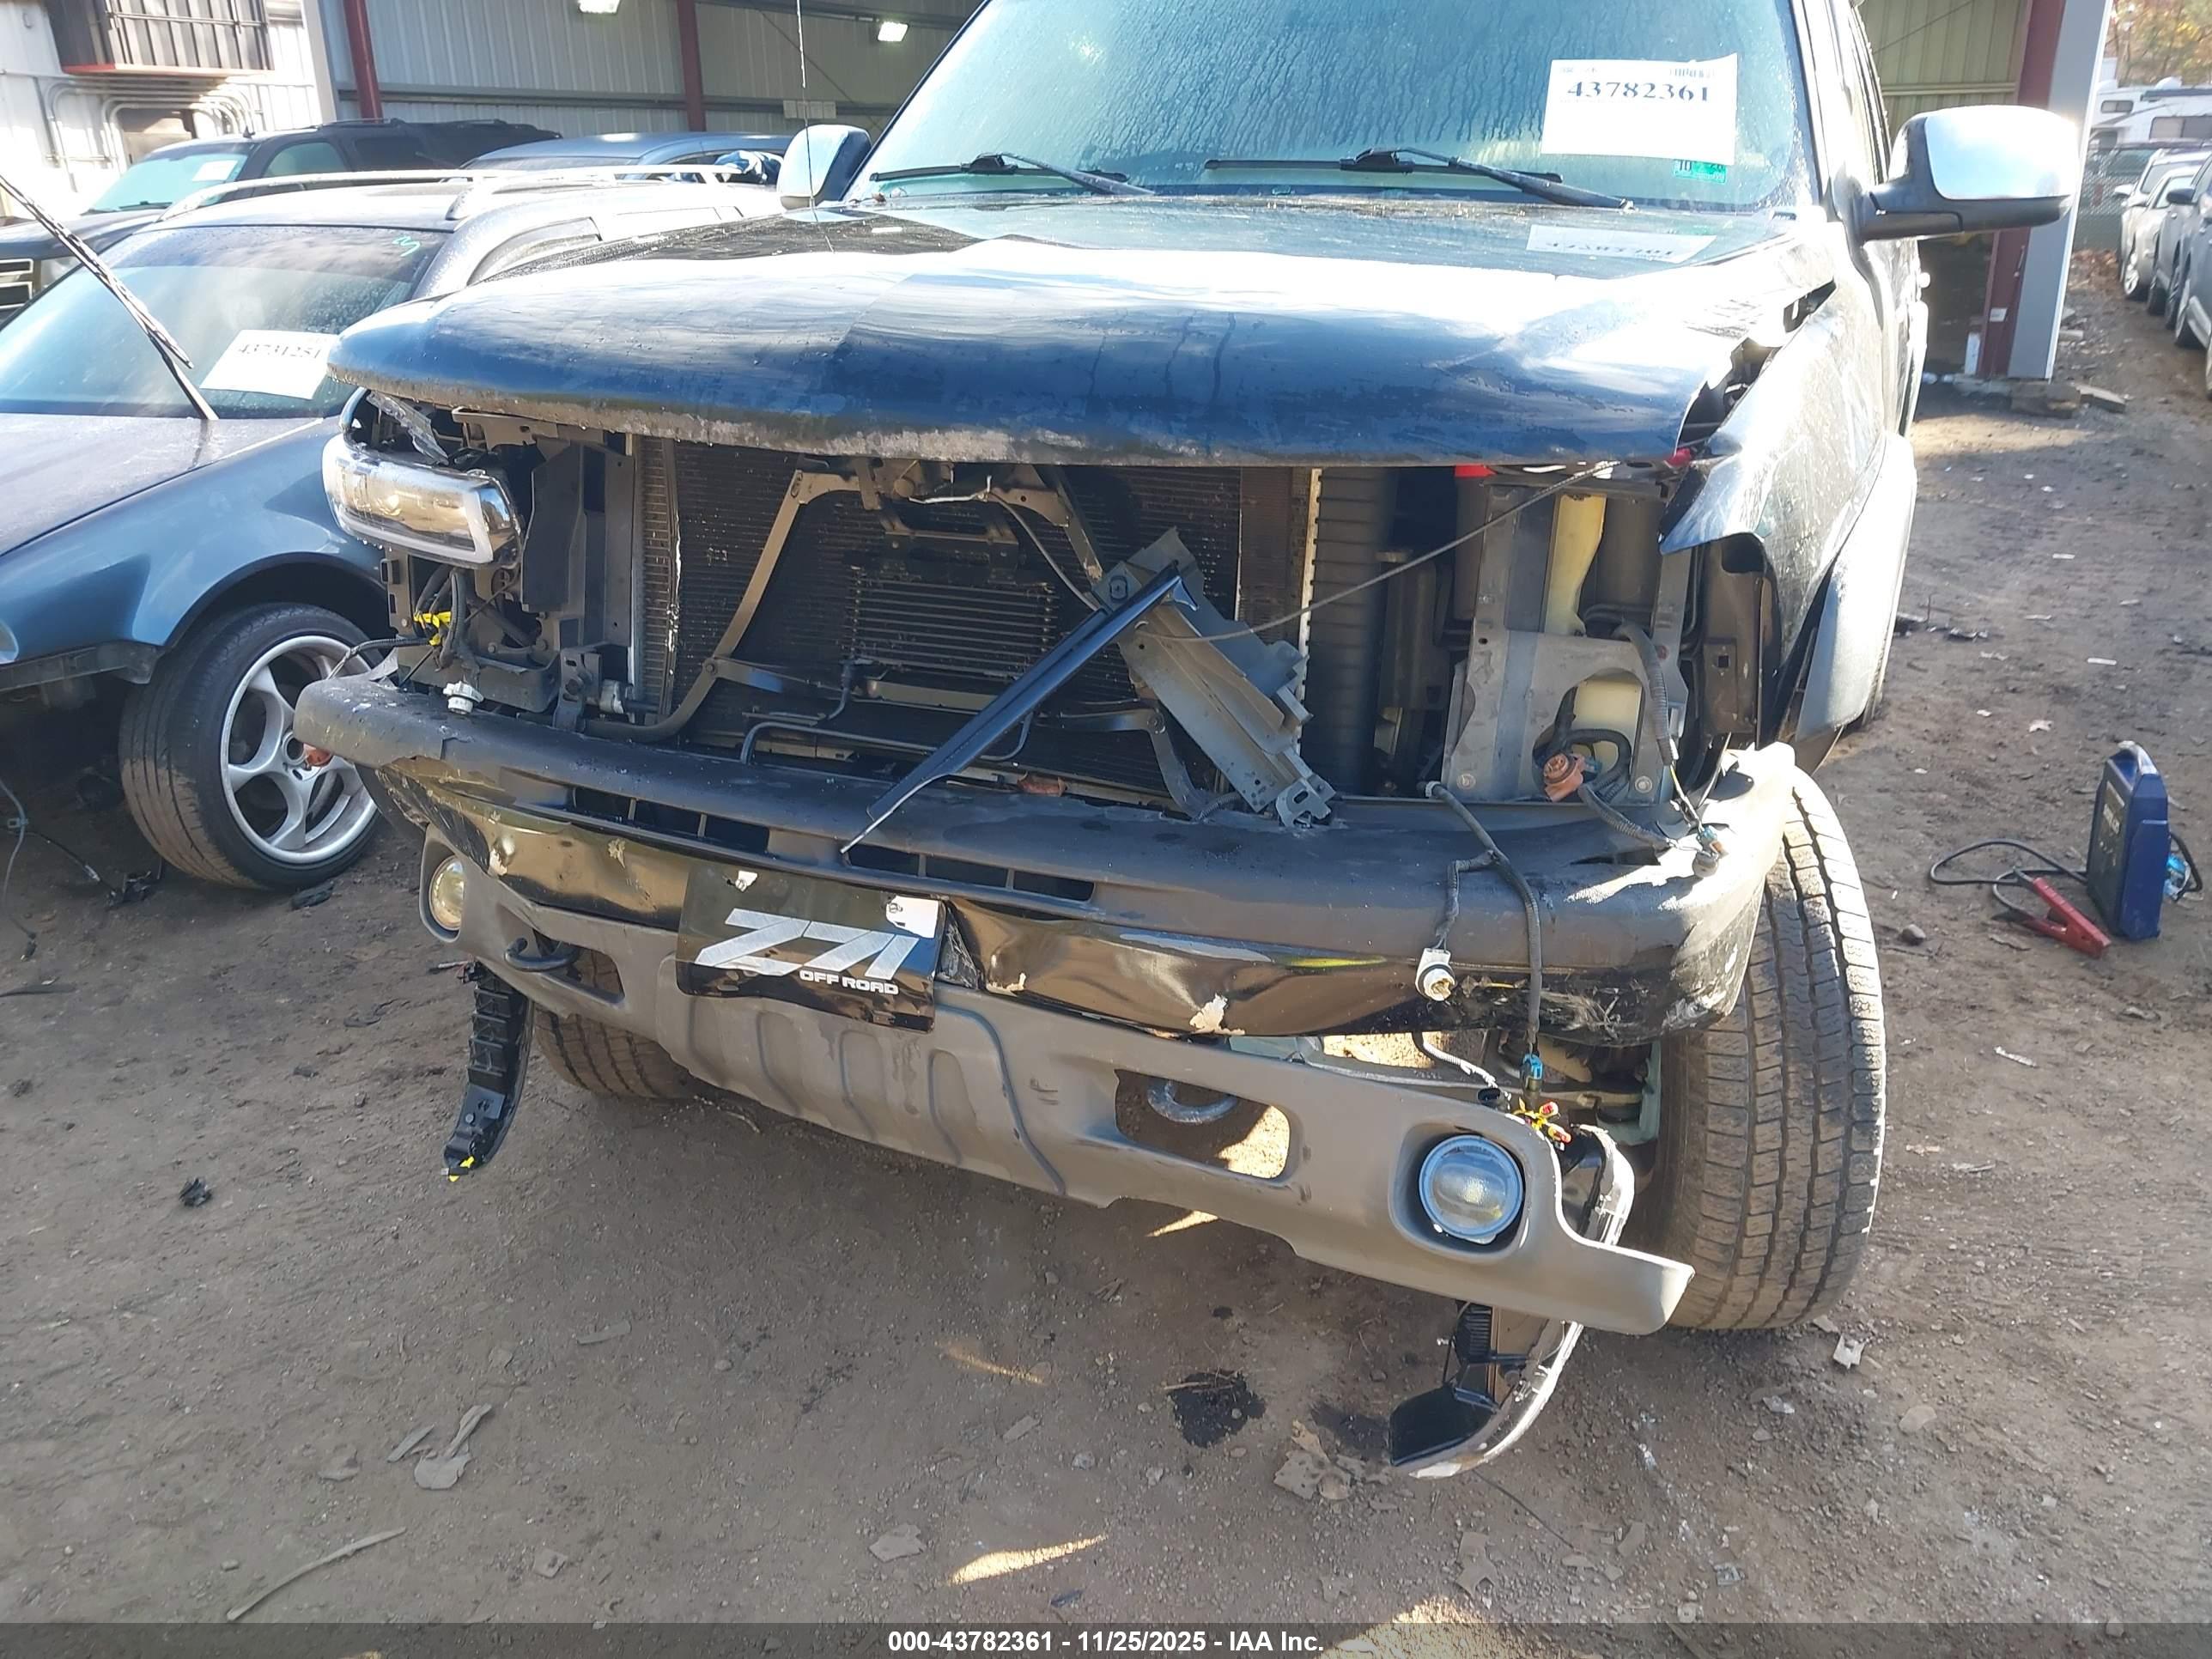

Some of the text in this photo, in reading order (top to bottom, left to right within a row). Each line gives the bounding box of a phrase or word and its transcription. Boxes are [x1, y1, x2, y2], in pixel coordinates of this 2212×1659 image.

[1567, 82, 1707, 101] 43782361
[694, 908, 919, 981] Z71
[799, 970, 900, 995] OFF ROAD
